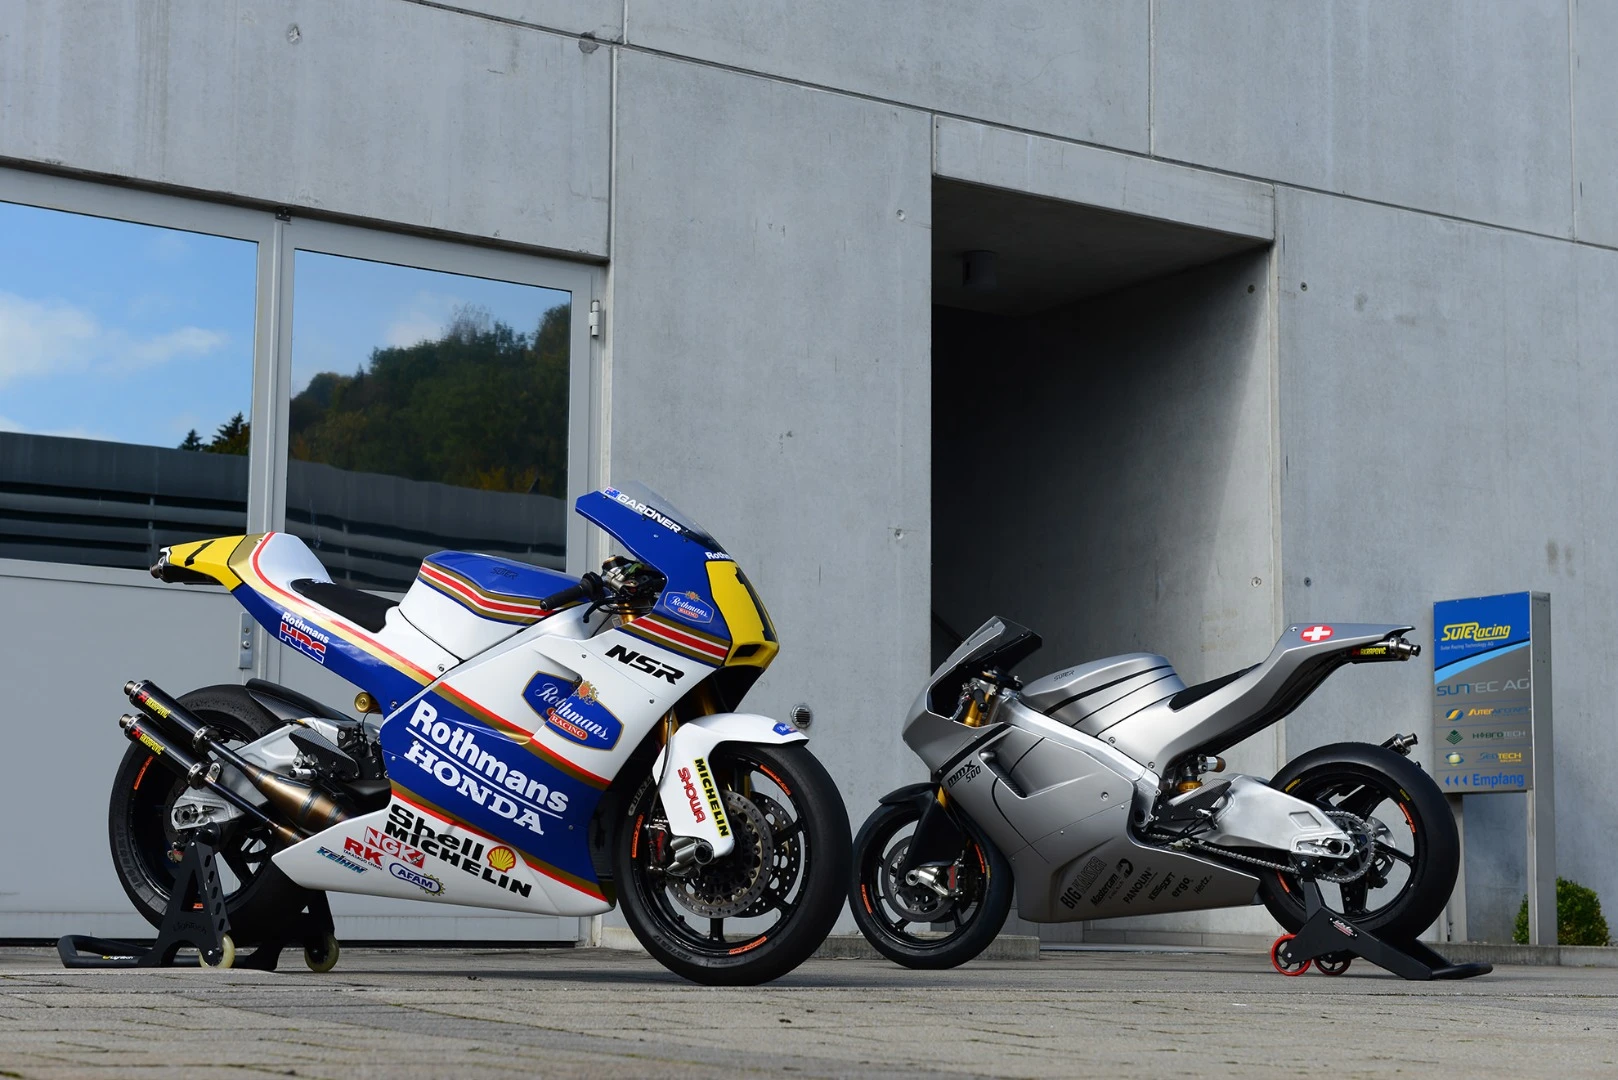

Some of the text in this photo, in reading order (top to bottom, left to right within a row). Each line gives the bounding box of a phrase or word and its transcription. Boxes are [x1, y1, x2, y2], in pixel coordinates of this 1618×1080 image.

[616, 493, 682, 533] GARDNER
[669, 595, 708, 618] Rothmans
[279, 622, 329, 665] HRC
[282, 611, 330, 644] Rothmans
[605, 645, 685, 685] NSR
[1503, 679, 1530, 691] AG
[535, 682, 609, 741] Rothmans
[551, 713, 584, 737] RACING
[409, 699, 569, 812] Rothmans
[965, 765, 982, 783] 500
[403, 740, 545, 835] HONDA
[677, 767, 707, 824] SHOWA
[694, 758, 730, 837] MICHELIN
[1472, 772, 1525, 788] Empfang
[343, 837, 386, 867] RK
[365, 828, 420, 866] NGK
[388, 803, 485, 862] Shell
[384, 820, 533, 898] MICHELIN
[397, 869, 433, 889] AFAM
[1060, 856, 1107, 910] BIG KAISER
[1172, 877, 1190, 898] ergo
